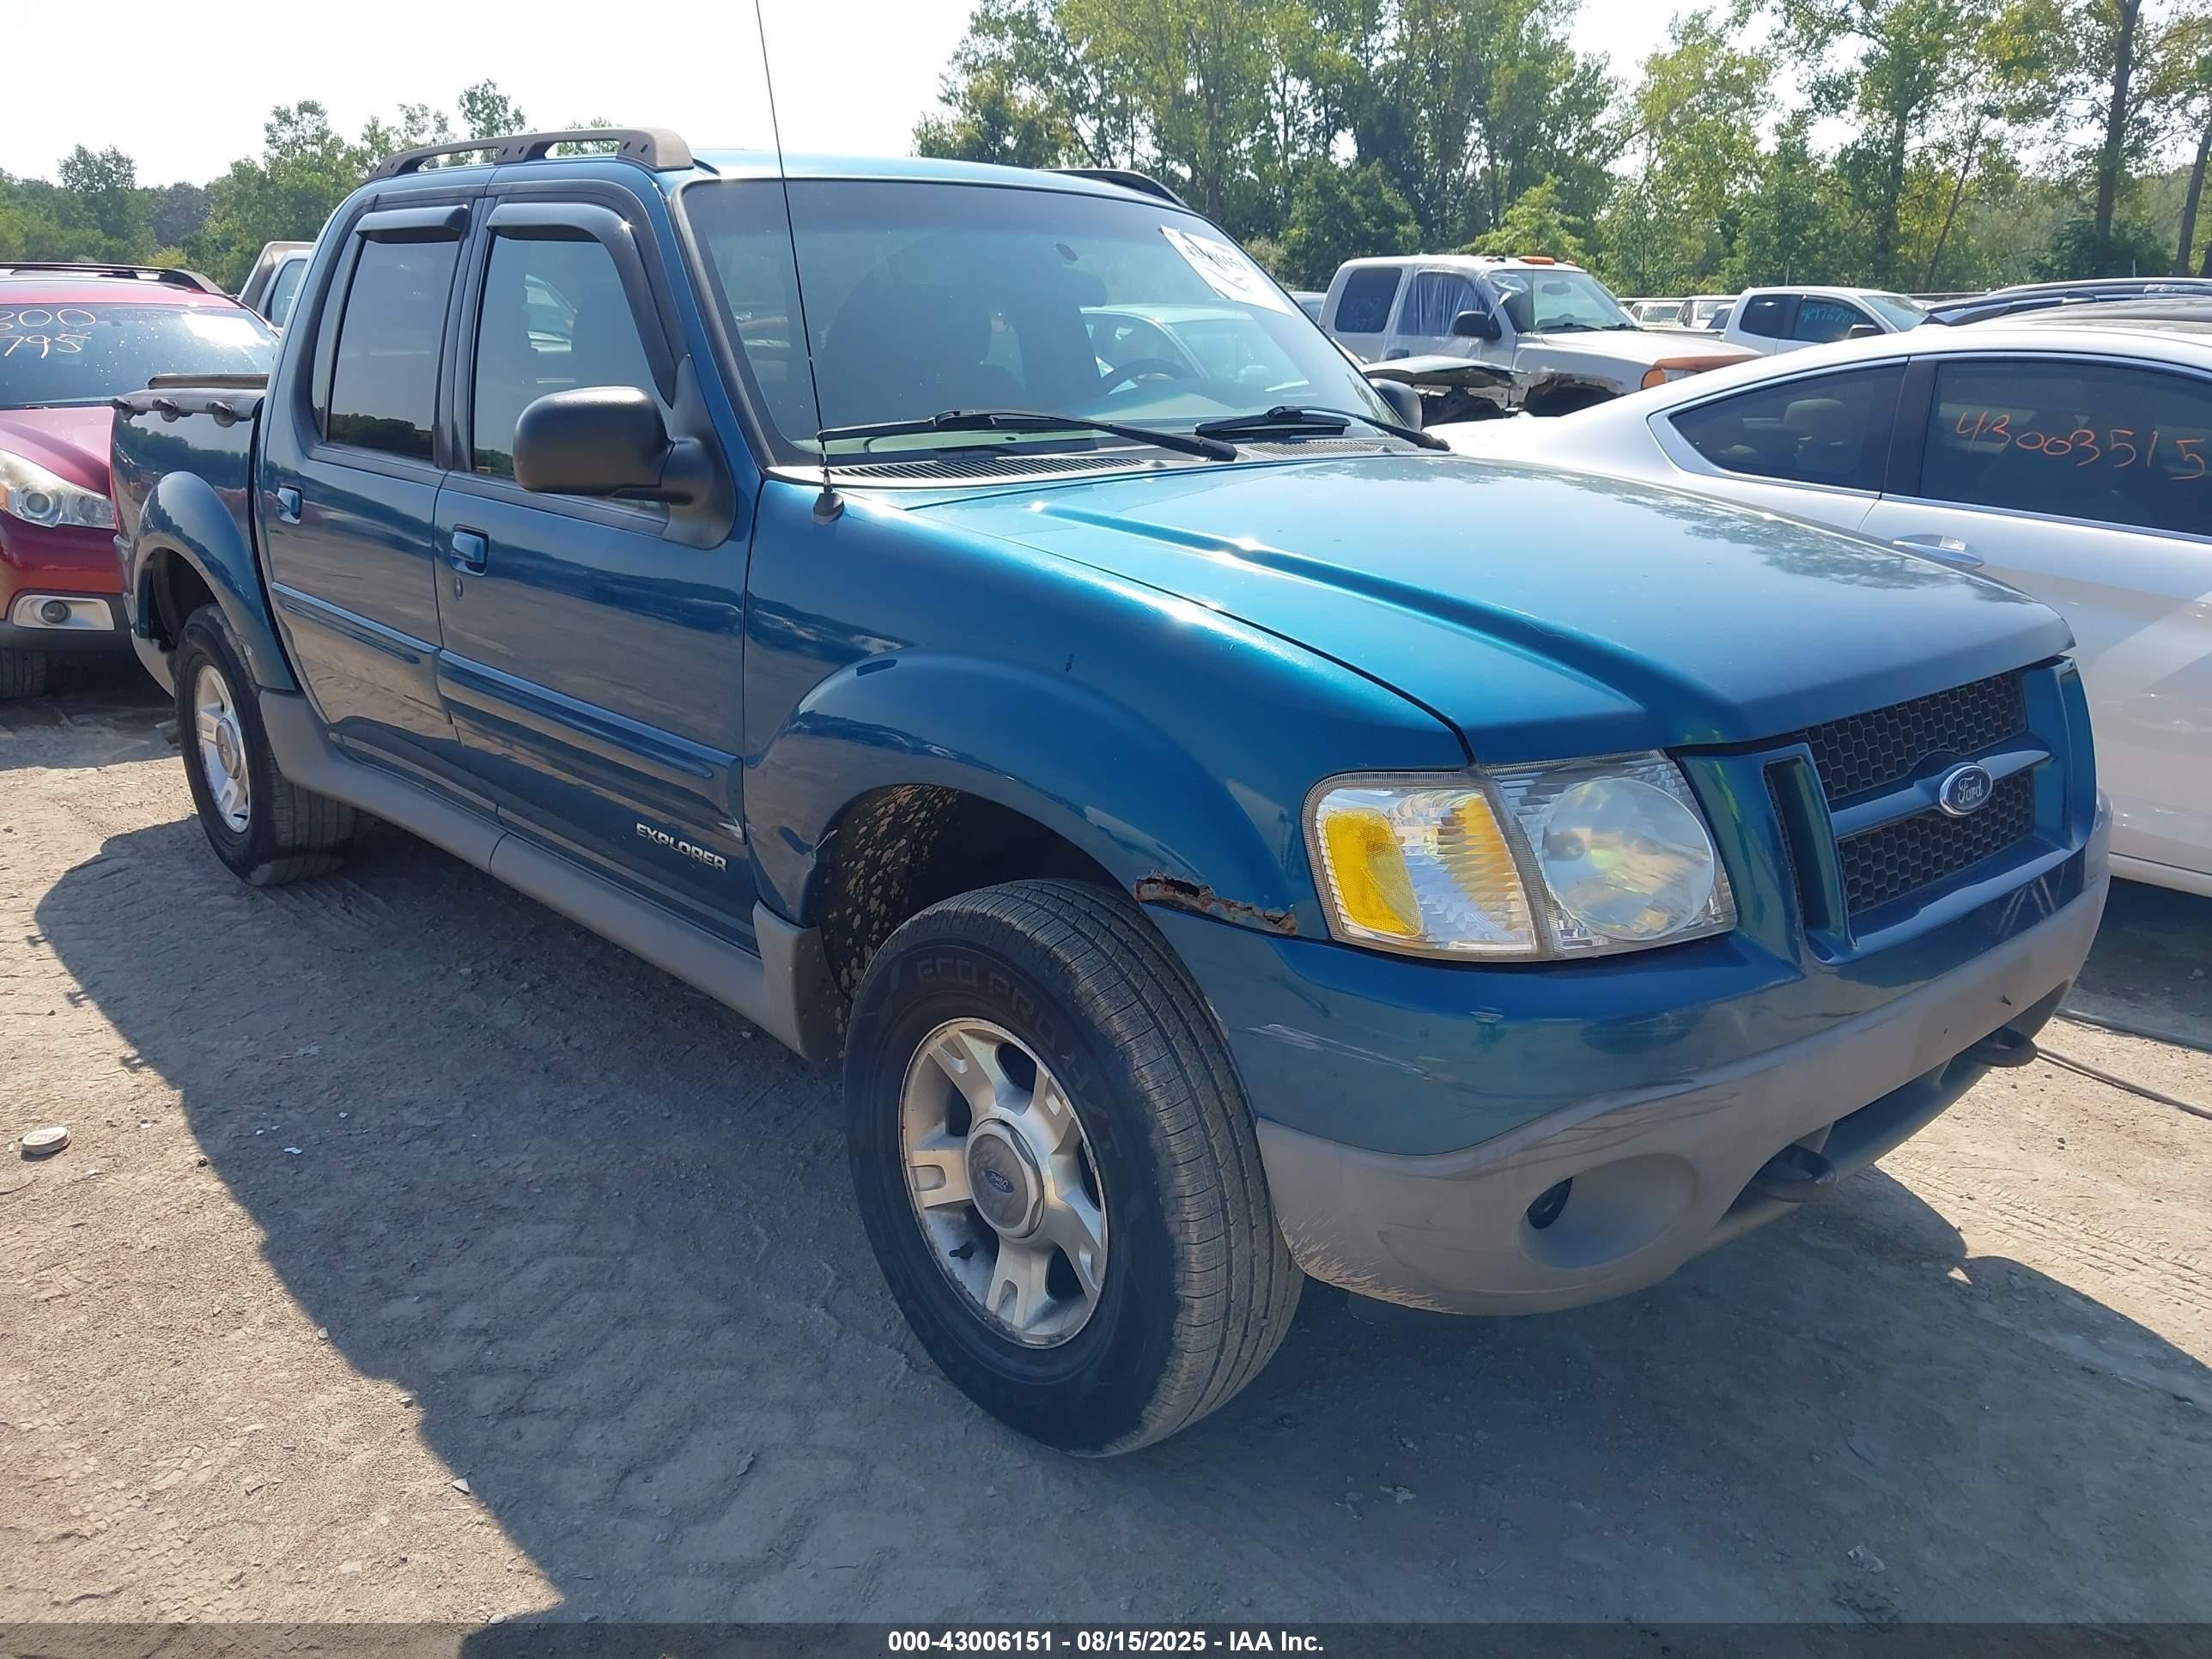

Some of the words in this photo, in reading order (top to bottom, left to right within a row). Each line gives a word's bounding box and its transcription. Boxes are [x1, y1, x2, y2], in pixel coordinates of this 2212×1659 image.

[1955, 410, 2206, 481] 43003515
[1957, 775, 1984, 805] Ford
[635, 822, 728, 872] EXPLORER
